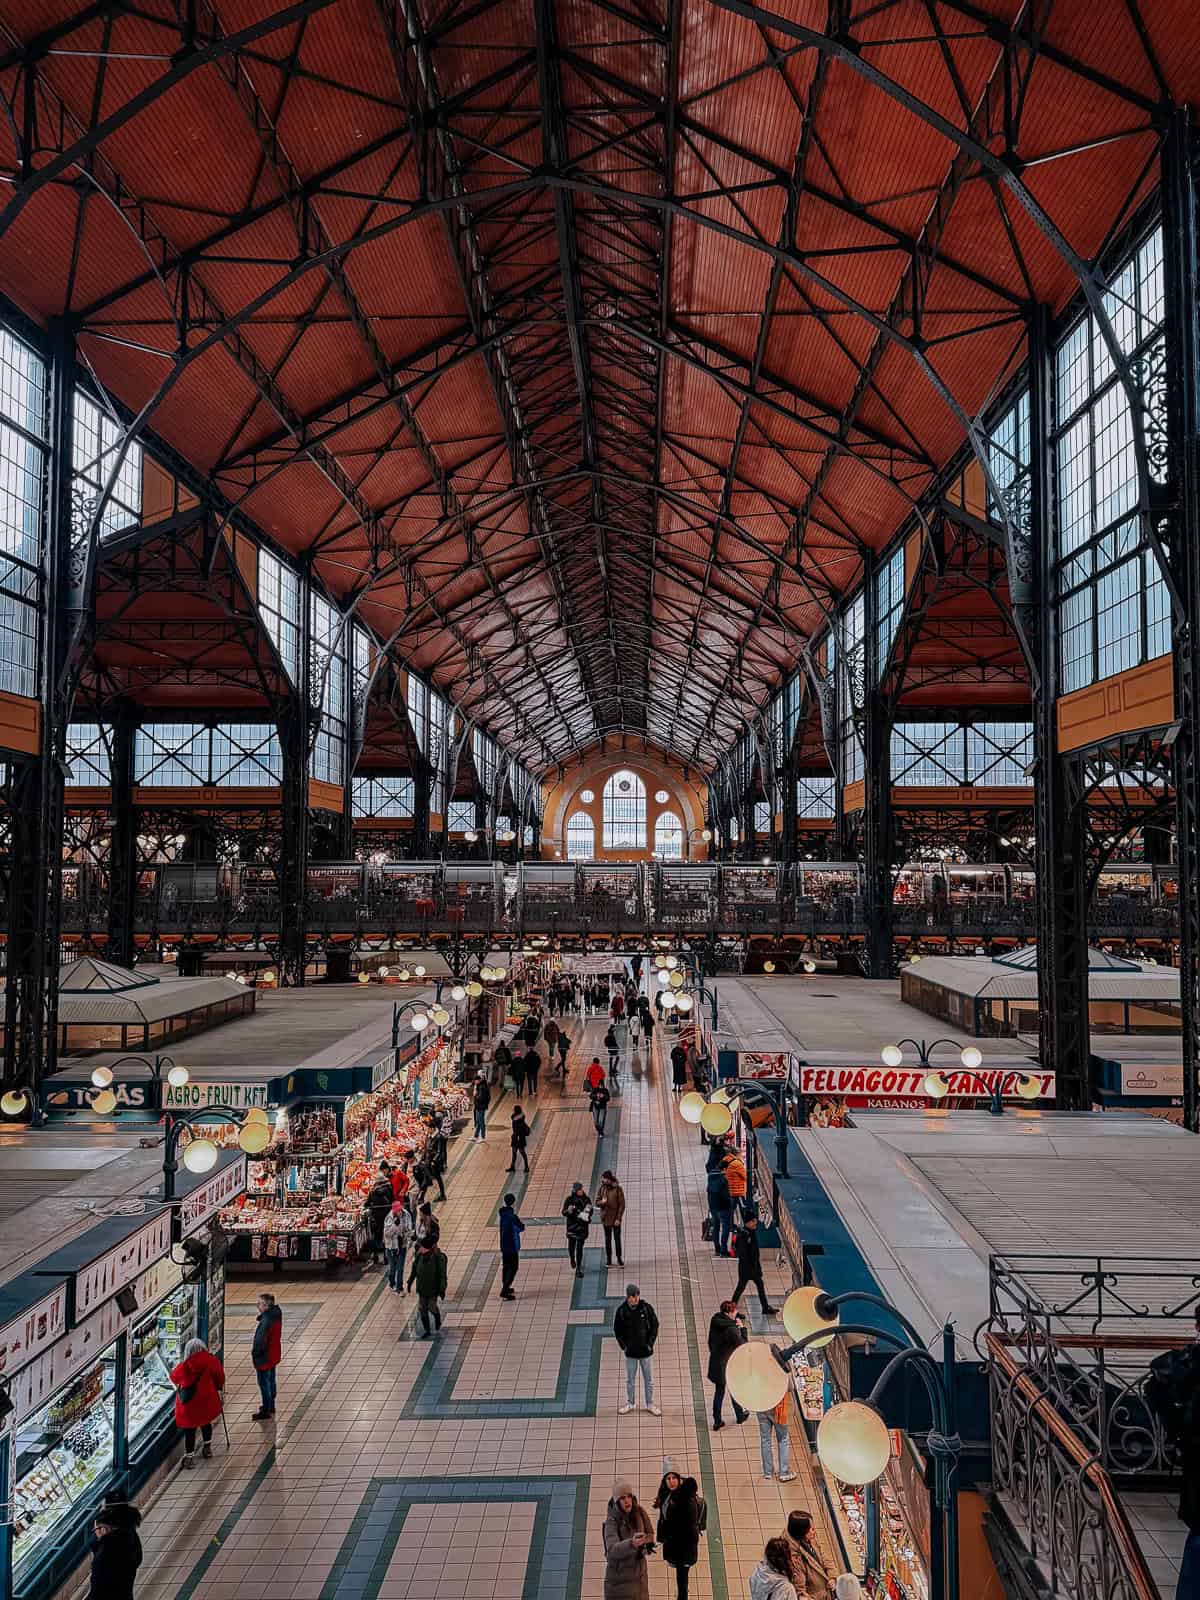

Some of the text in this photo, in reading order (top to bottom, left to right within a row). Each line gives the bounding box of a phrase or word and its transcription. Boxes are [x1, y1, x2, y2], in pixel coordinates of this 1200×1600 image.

[803, 1069, 1055, 1095] FELVÁGOTT ZAKÜZT
[72, 1083, 145, 1106] TOÁS
[166, 1085, 241, 1106] AGRO-FRUIT
[867, 1098, 926, 1109] KABANOS
